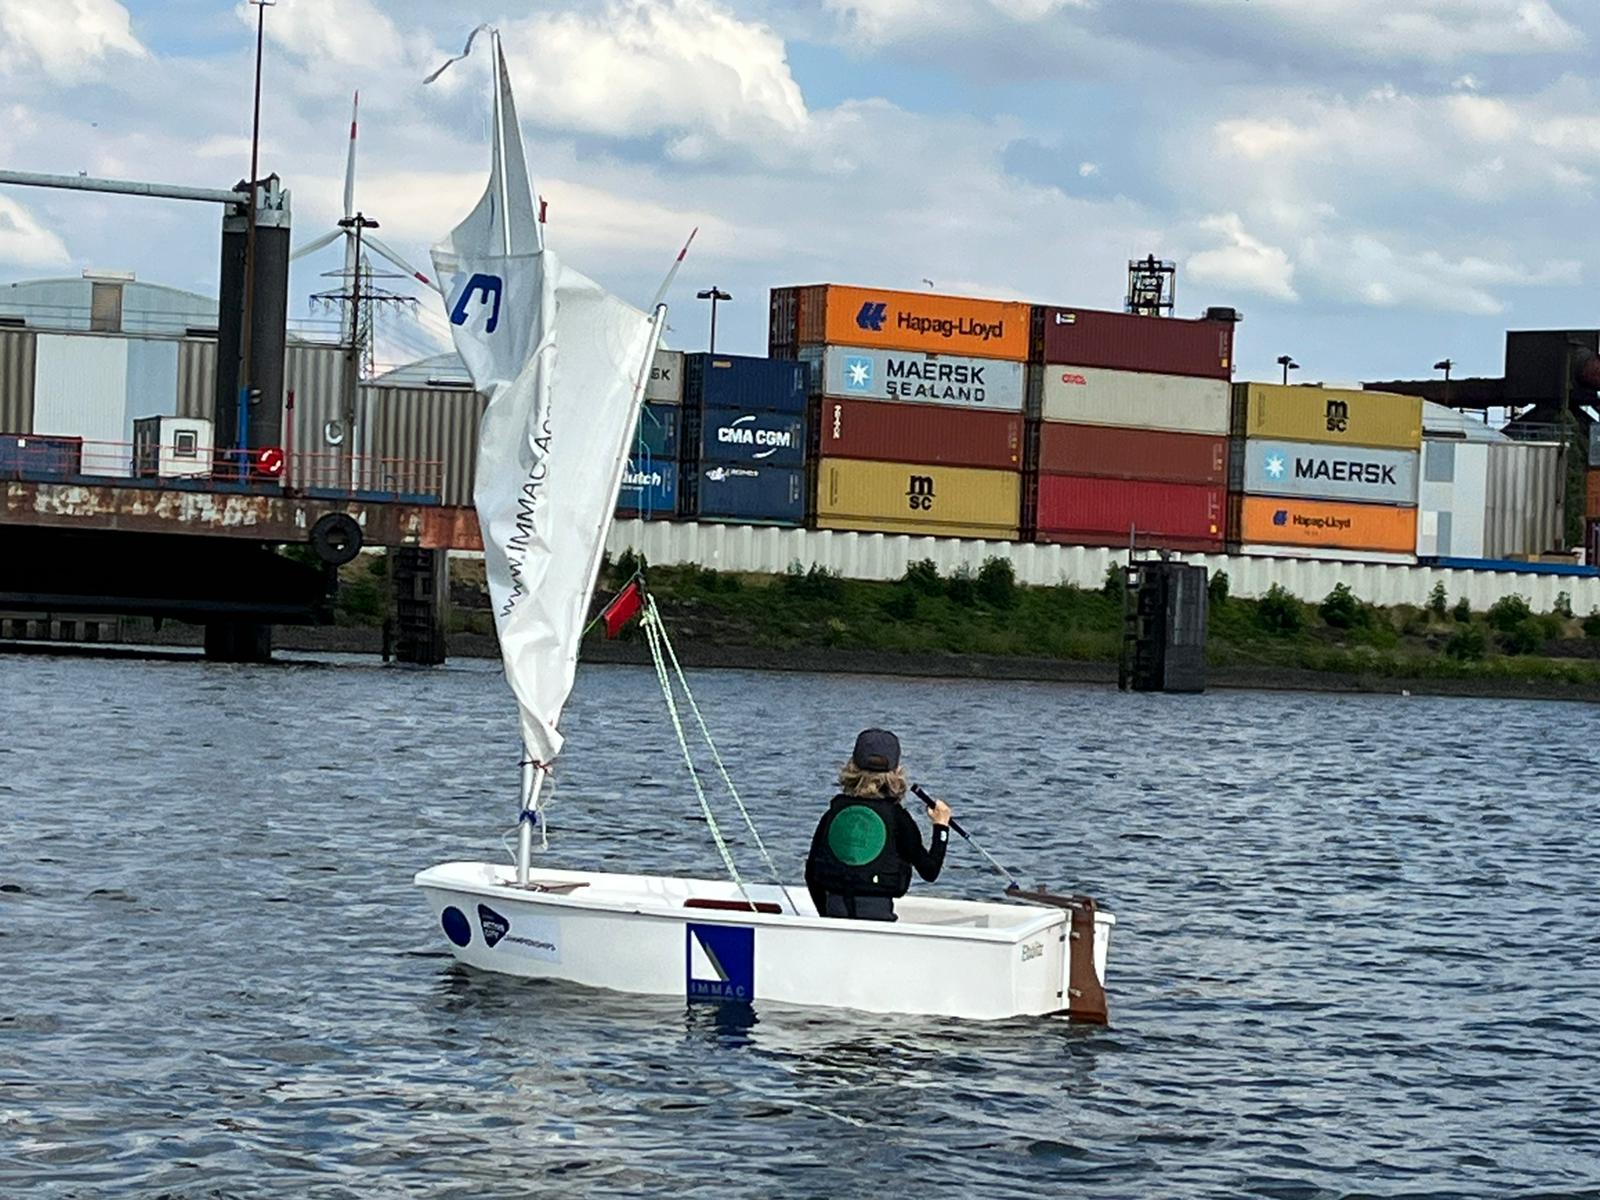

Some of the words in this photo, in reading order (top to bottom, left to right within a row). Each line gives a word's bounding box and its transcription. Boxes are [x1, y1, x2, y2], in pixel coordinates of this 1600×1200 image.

[897, 311, 1003, 341] Hapag-Lloyd
[886, 358, 985, 385] MAERSK
[885, 380, 986, 402] SEALAND
[717, 427, 754, 445] CMA
[755, 429, 791, 447] CGM
[1295, 457, 1397, 485] MAERSK
[691, 981, 746, 998] IMMAC
